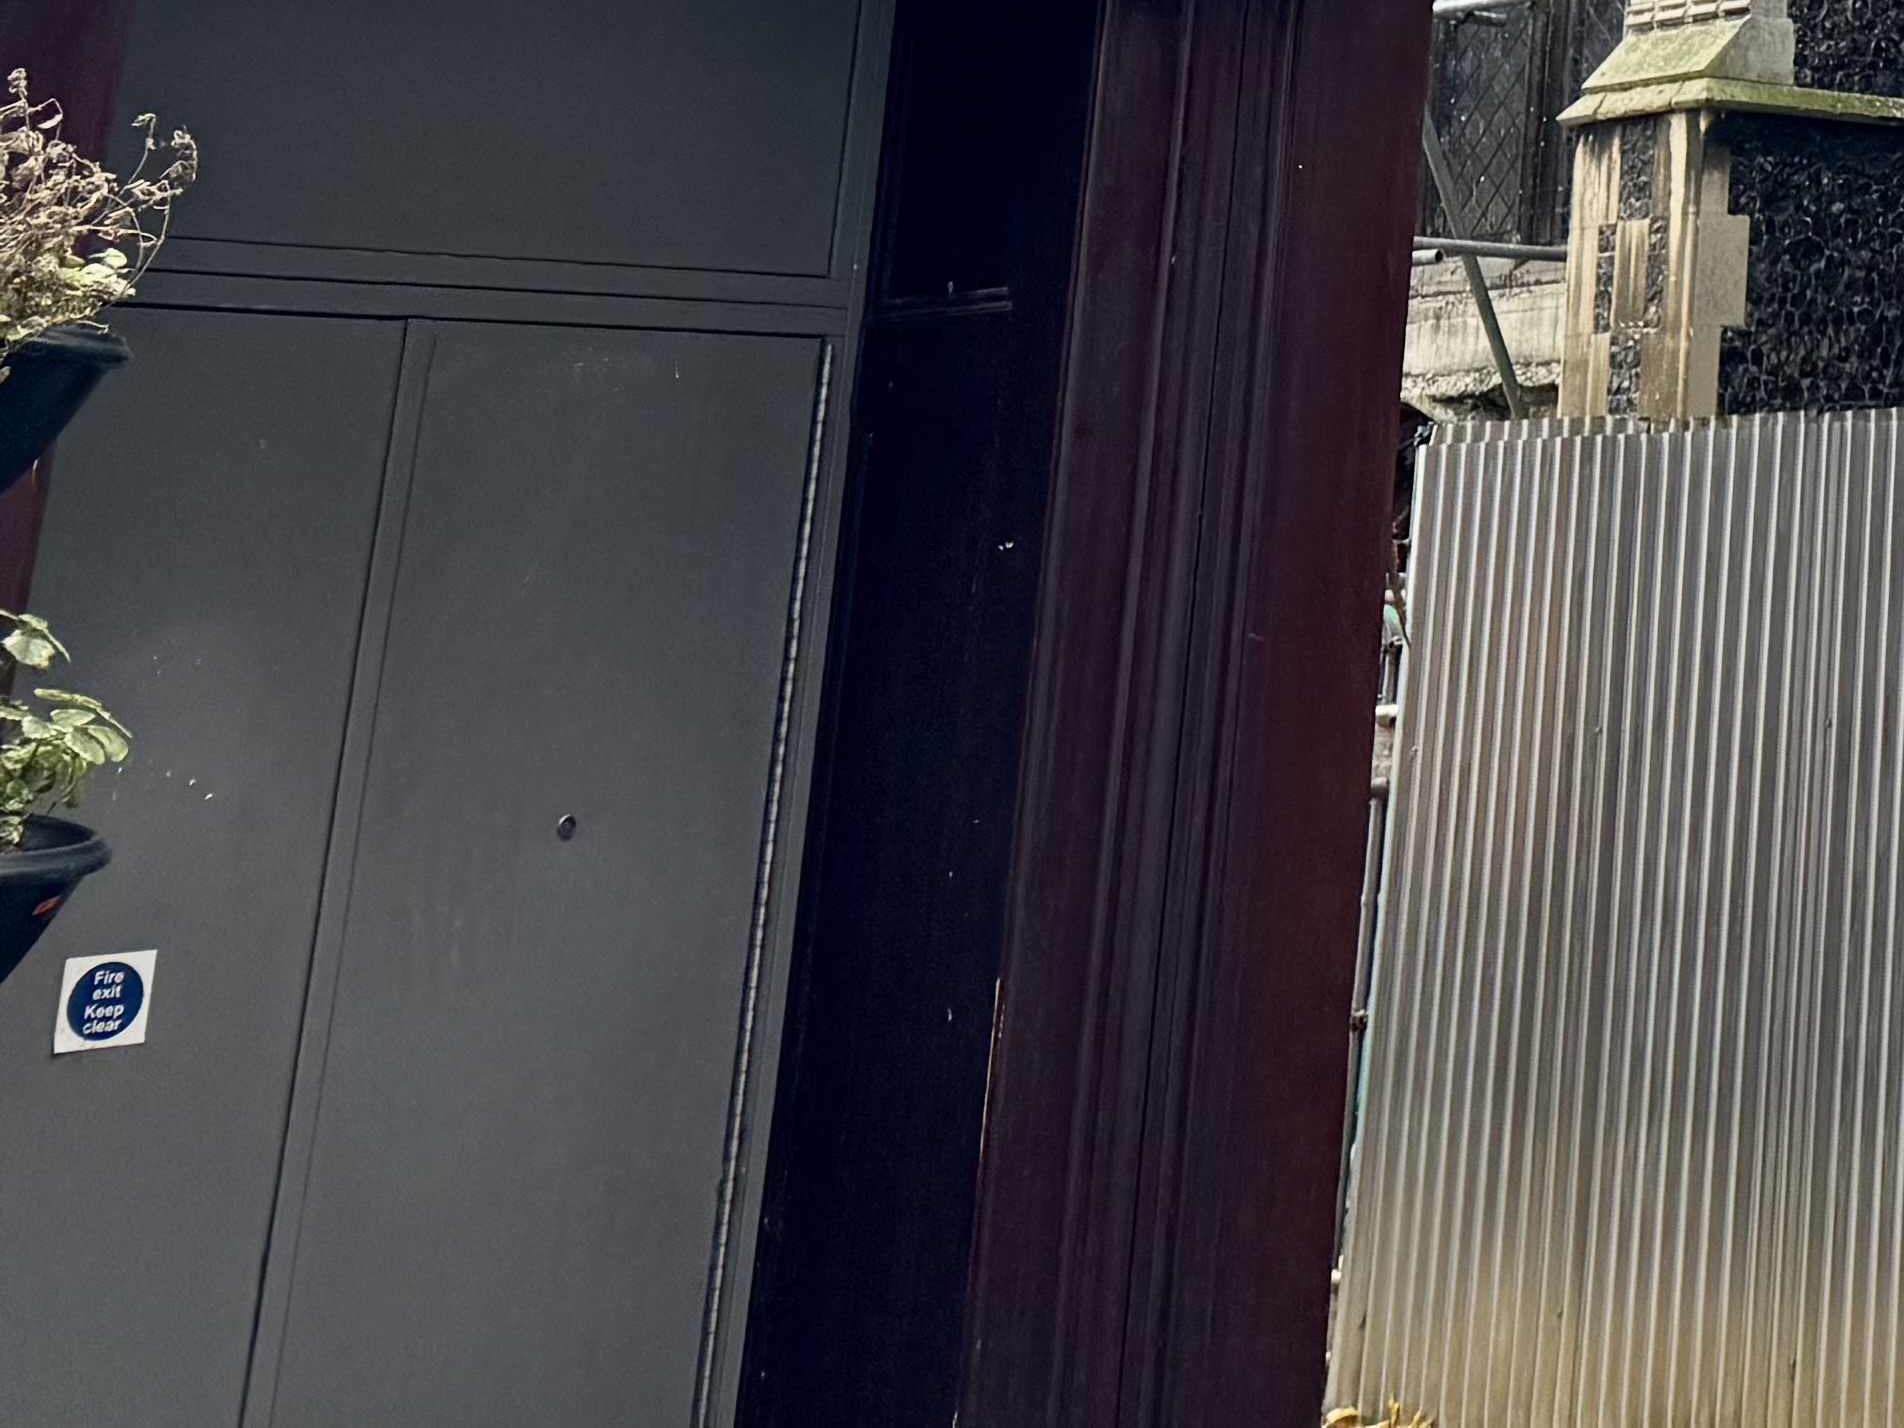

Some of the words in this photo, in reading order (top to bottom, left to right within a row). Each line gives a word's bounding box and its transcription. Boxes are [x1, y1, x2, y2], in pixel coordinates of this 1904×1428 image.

[93, 970, 125, 986] Fire
[92, 985, 122, 1001] exit
[83, 1003, 125, 1020] Keep
[82, 1019, 123, 1035] clear
